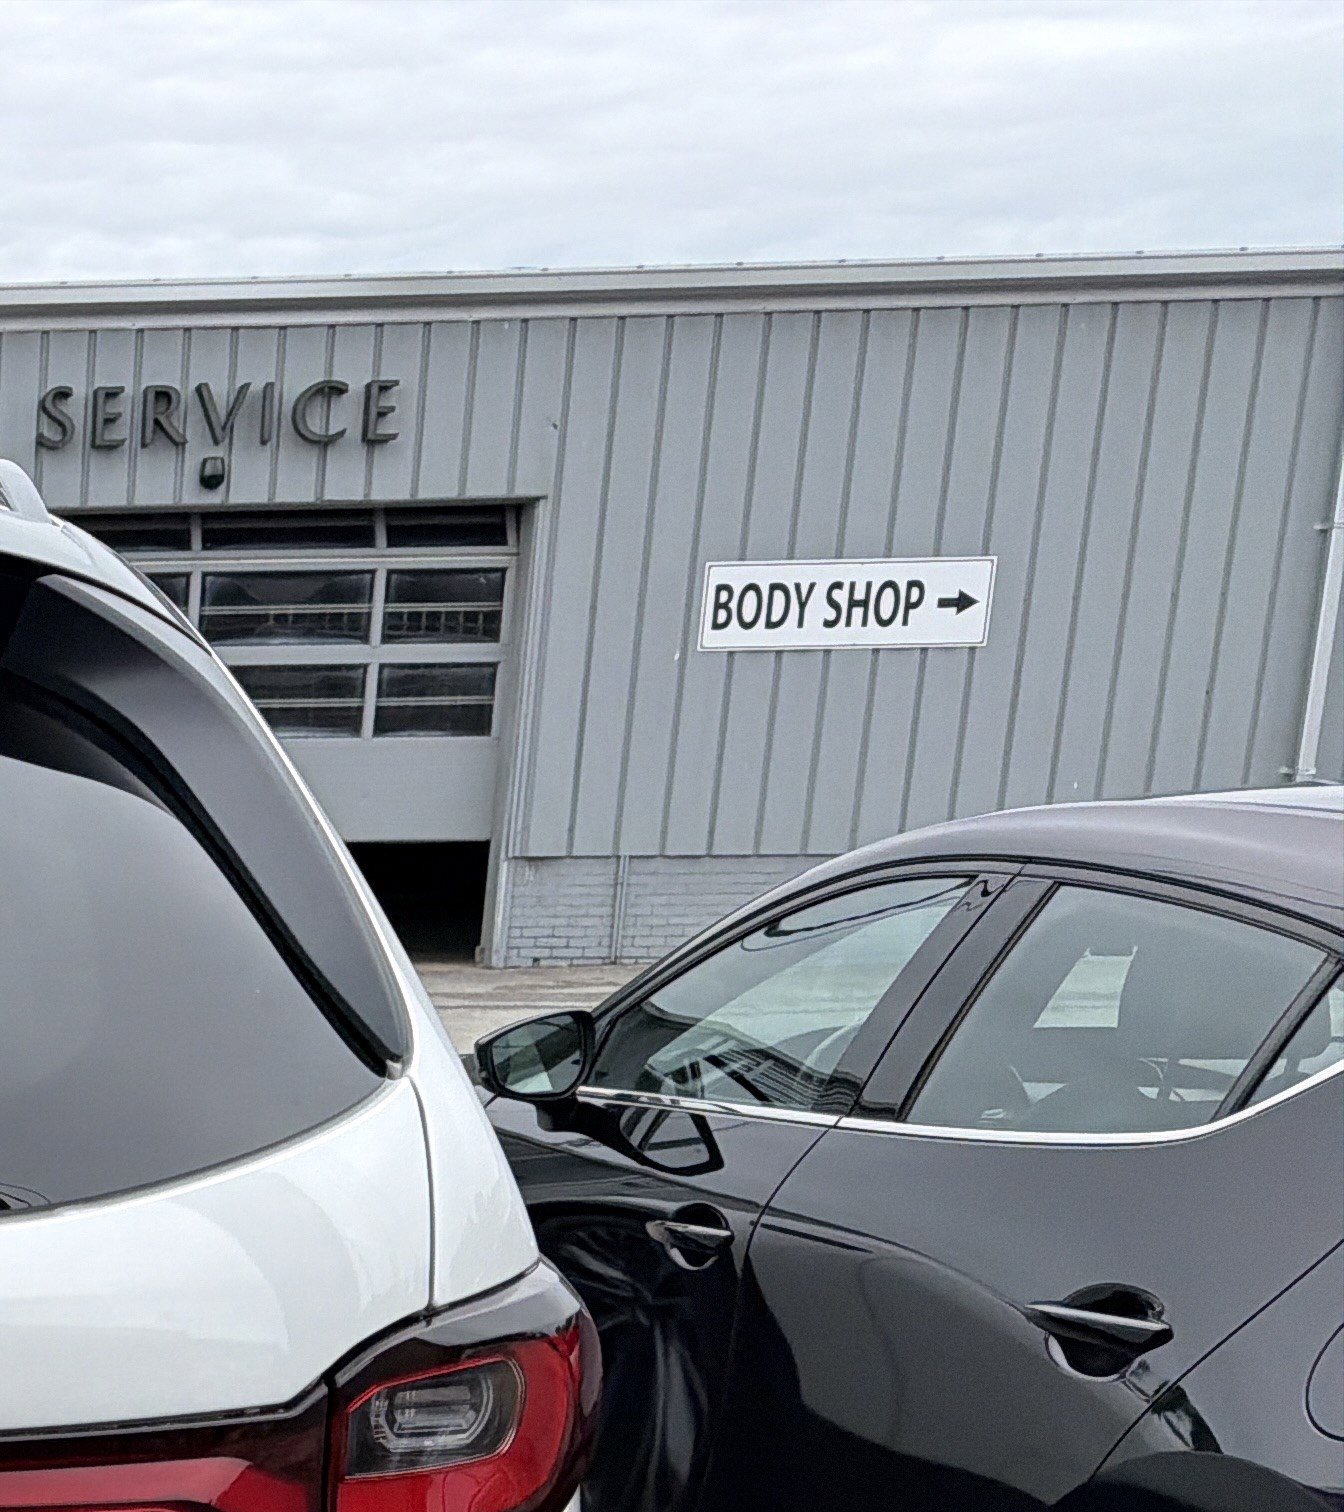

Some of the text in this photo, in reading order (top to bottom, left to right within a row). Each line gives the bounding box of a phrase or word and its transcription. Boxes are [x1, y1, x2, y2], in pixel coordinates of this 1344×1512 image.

[36, 378, 400, 450] SERVICE
[710, 579, 926, 631] BODY SHOP
